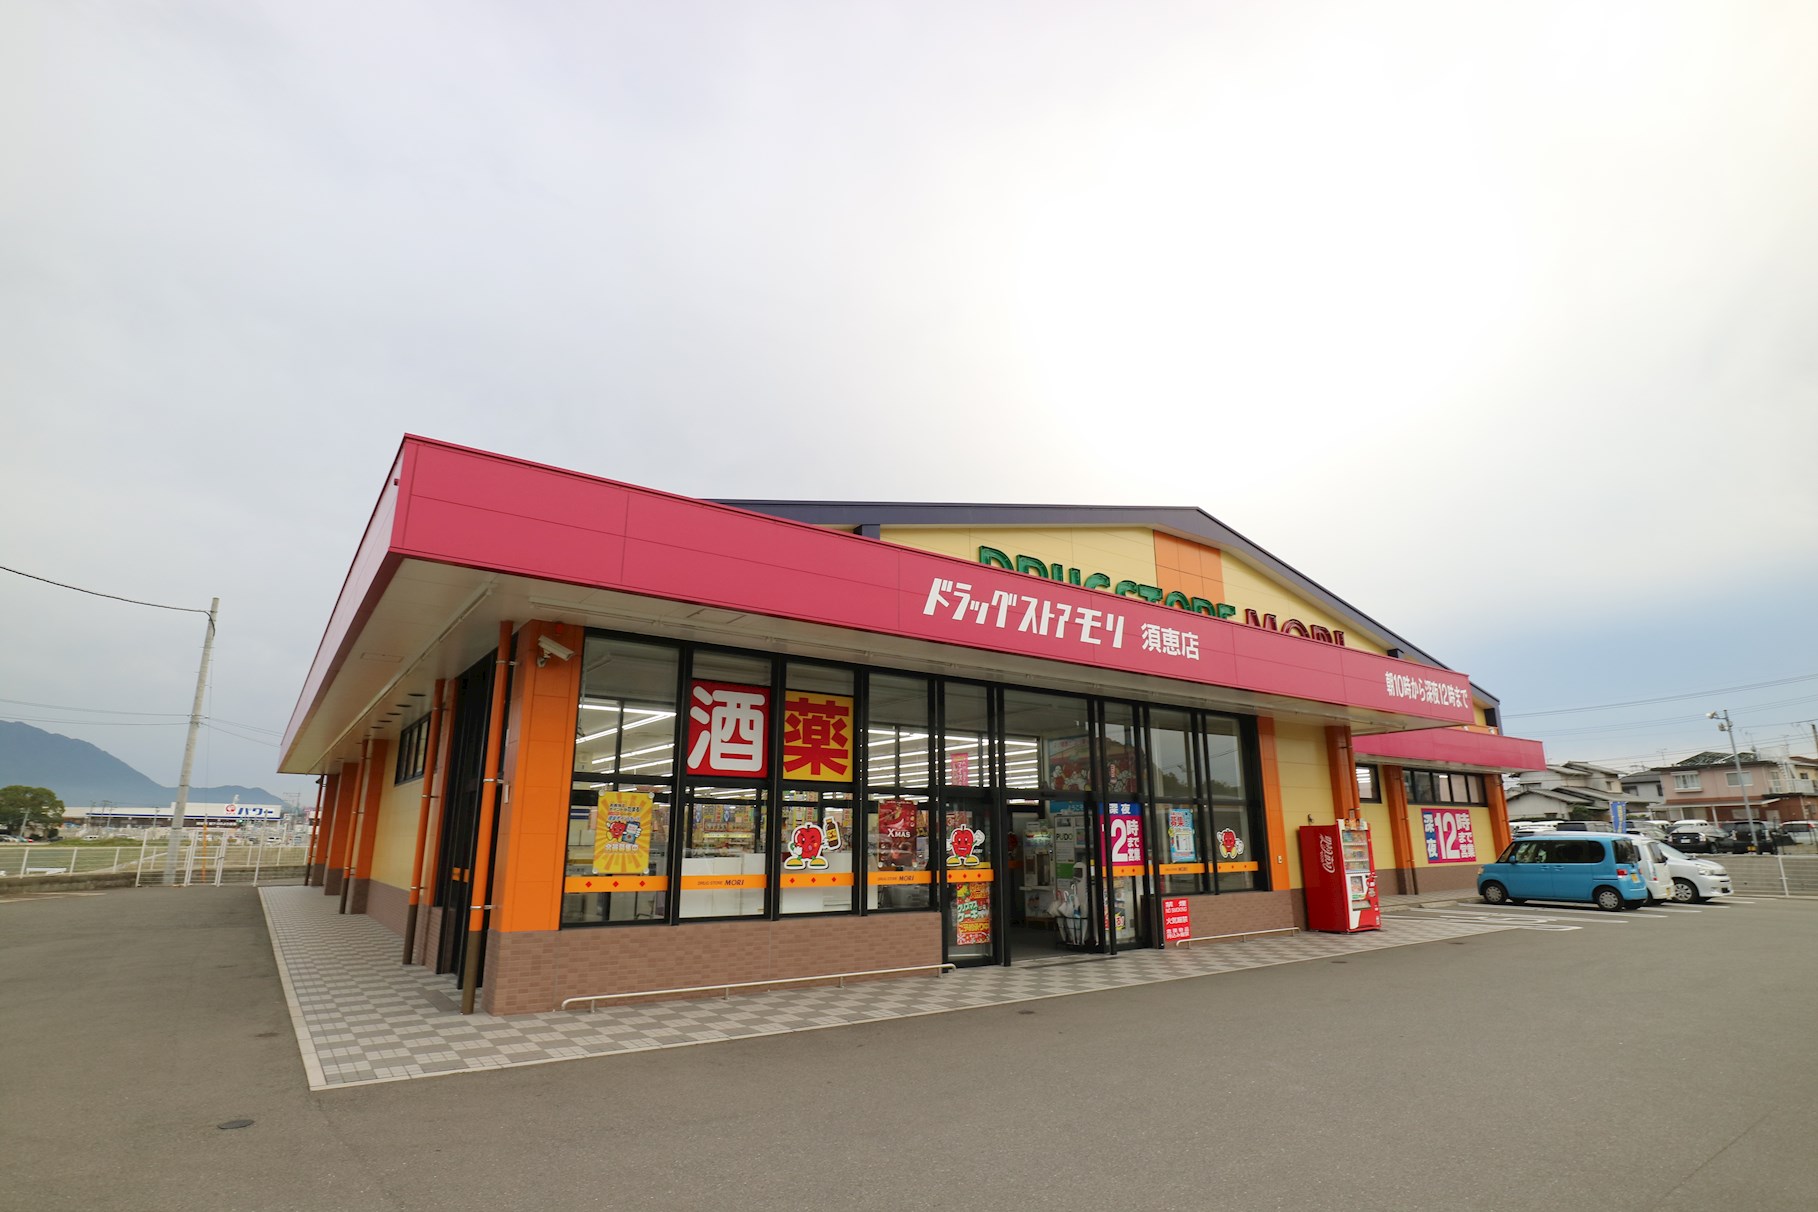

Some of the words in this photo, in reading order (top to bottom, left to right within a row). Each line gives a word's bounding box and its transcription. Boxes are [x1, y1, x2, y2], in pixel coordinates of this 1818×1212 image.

[922, 577, 1125, 649] ドラッグストアモリ
[1140, 622, 1200, 660] 須恵店
[1385, 671, 1469, 709] 朝10時から深夜12時まで
[687, 685, 766, 772] 酒
[783, 697, 849, 776] 薬
[237, 807, 273, 816] パワー
[1455, 813, 1470, 830] 時
[1126, 819, 1139, 835] 時
[1423, 813, 1438, 857] 深夜
[1434, 812, 1460, 859] 12
[1458, 831, 1473, 843] まで
[1127, 837, 1139, 847] まで
[1460, 843, 1475, 858] 営業
